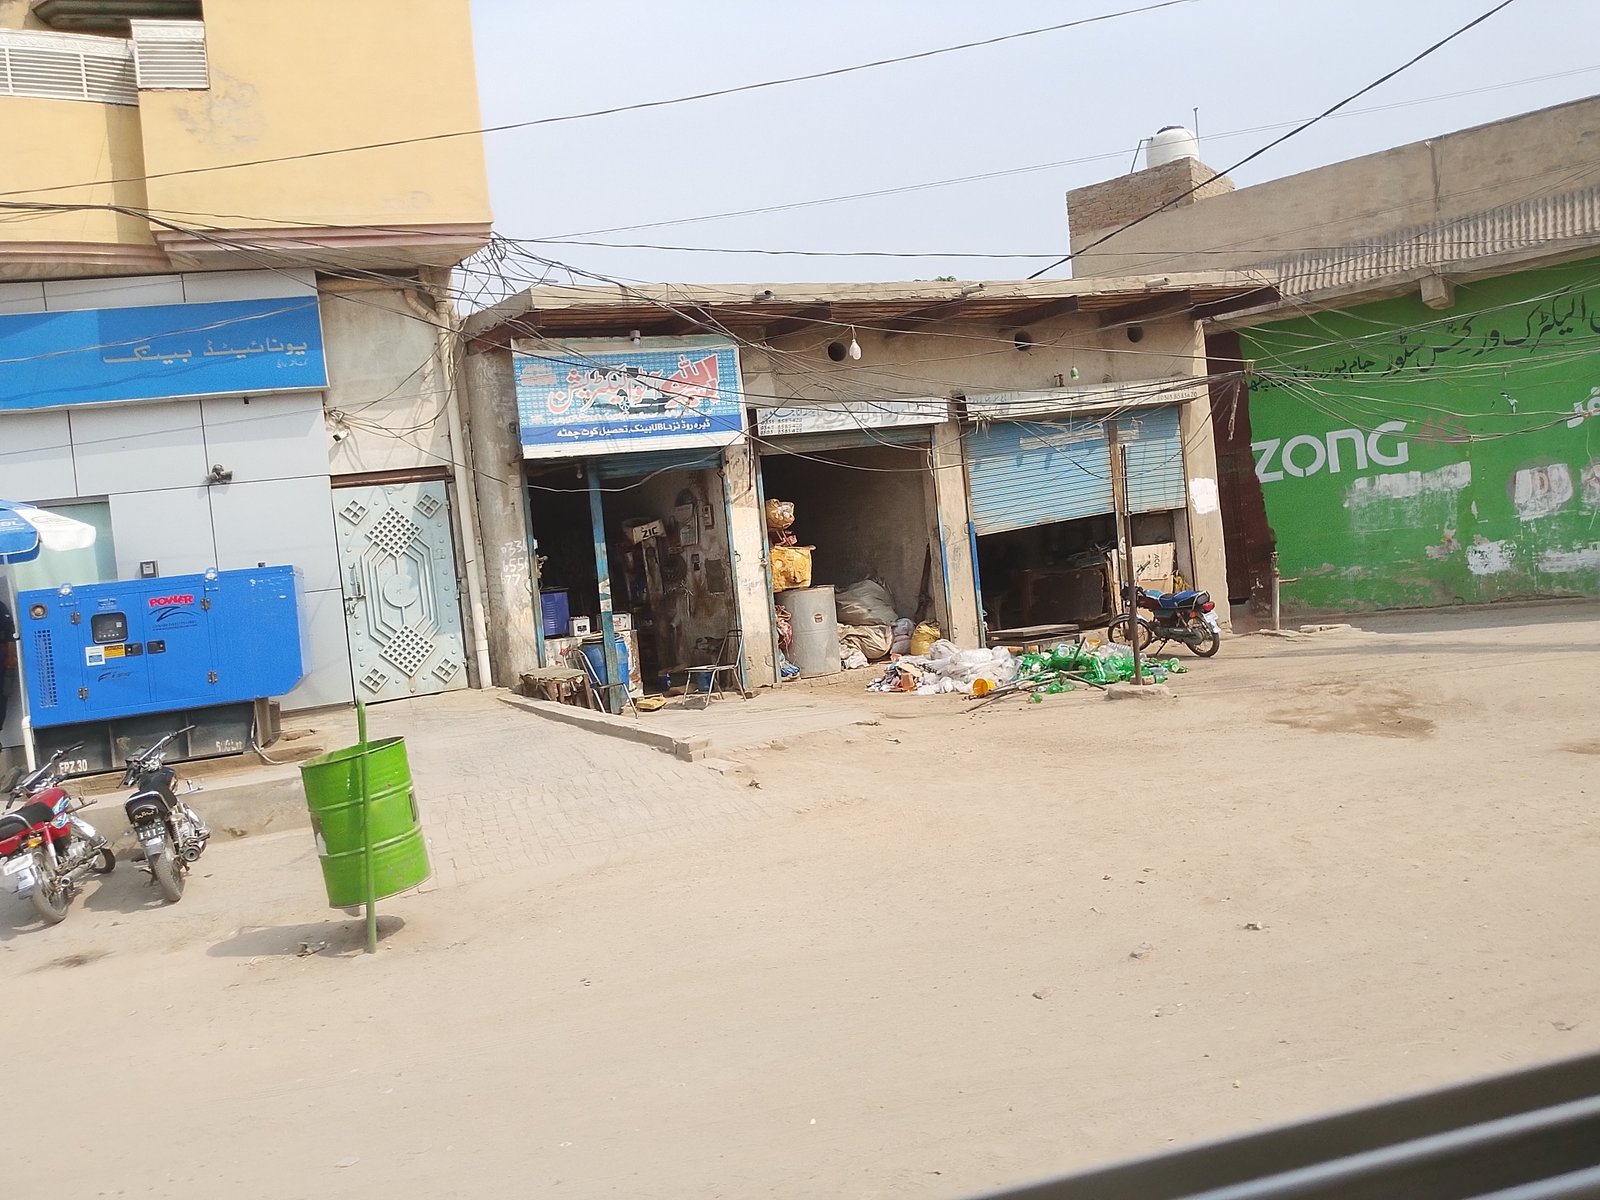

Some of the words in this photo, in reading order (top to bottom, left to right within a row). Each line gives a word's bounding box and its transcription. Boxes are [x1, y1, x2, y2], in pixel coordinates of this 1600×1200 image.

[600, 425, 629, 437] تحصیل
[681, 420, 694, 432] روڈ
[641, 526, 658, 539] ZIC
[148, 594, 195, 608] POWER
[77, 759, 88, 772] 30
